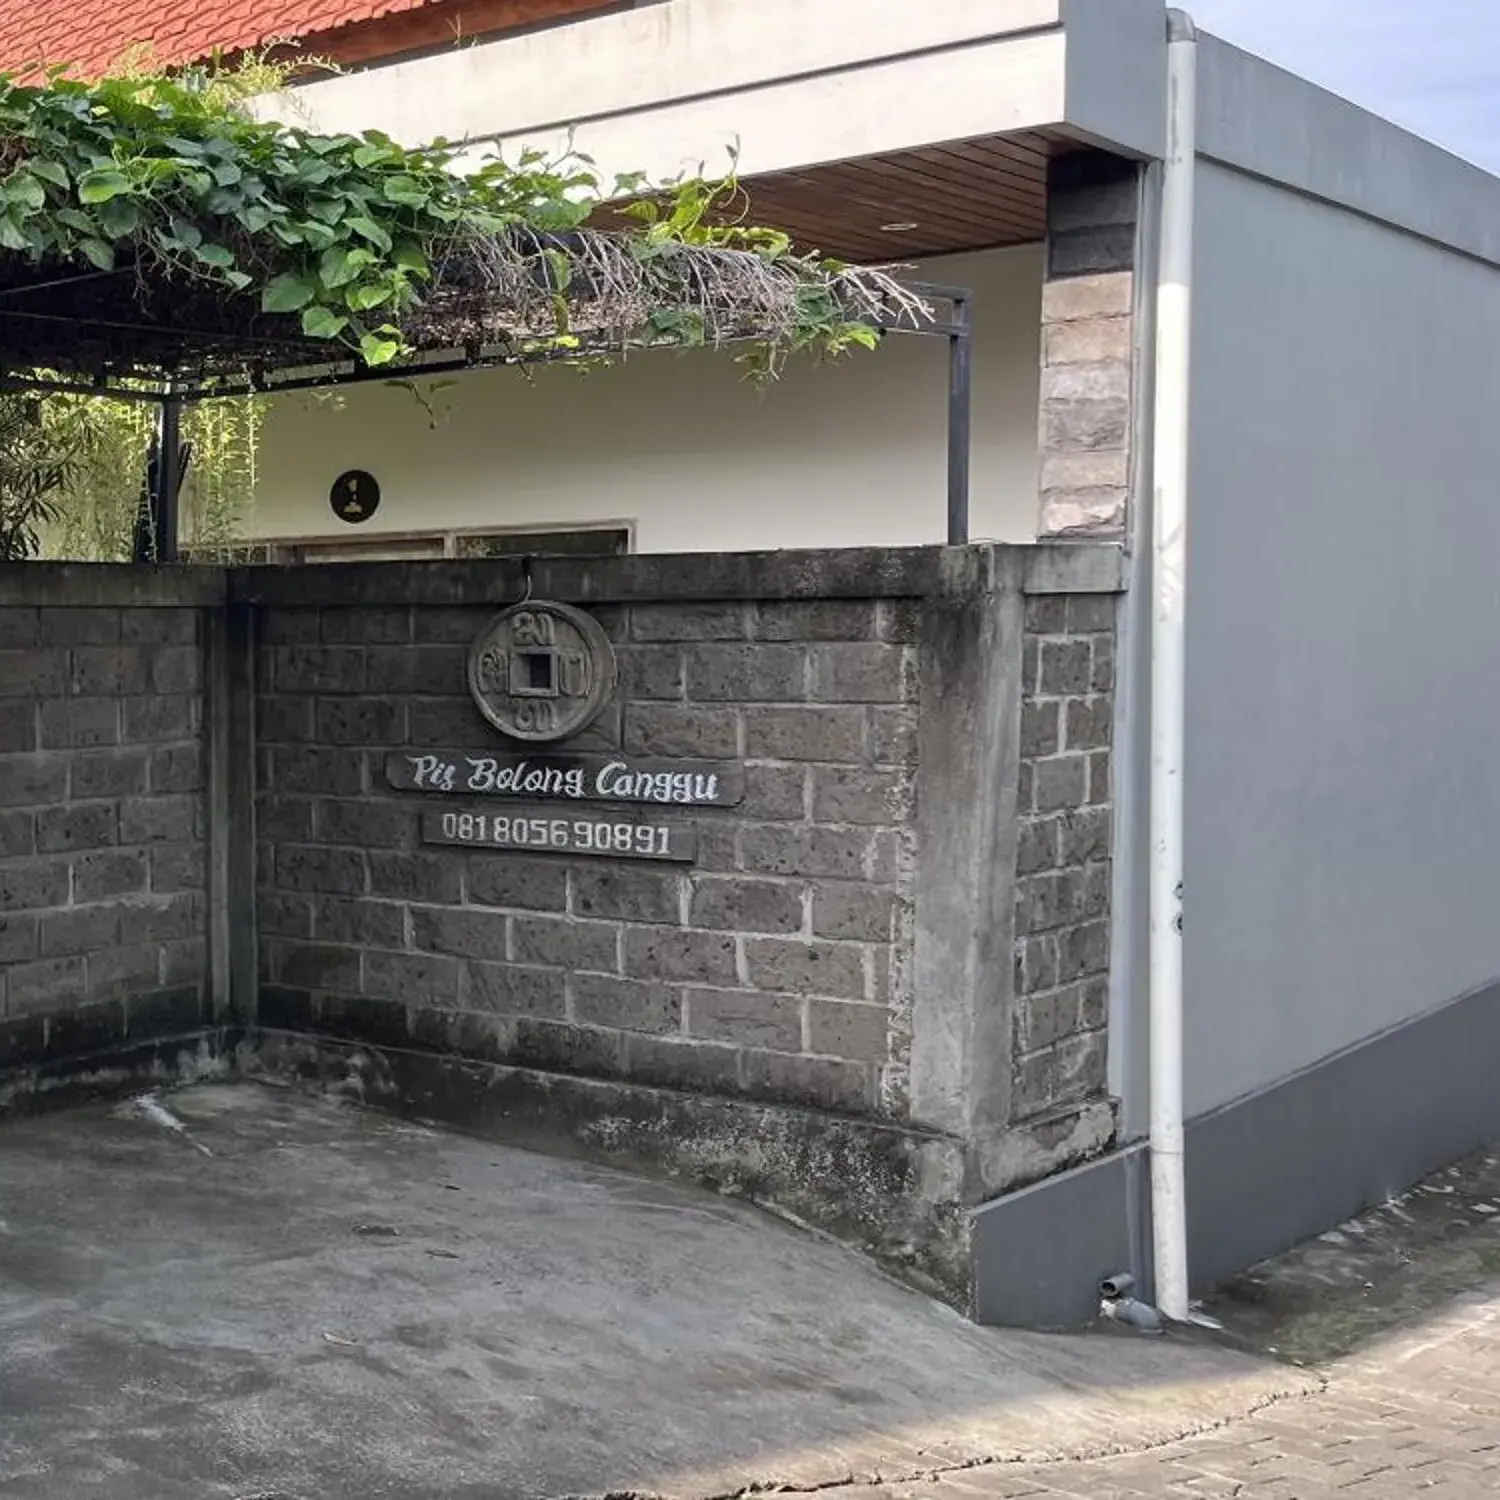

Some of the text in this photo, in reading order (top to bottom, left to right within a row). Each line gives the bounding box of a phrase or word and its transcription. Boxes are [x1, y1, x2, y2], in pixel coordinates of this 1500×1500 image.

[406, 755, 719, 802] Pis Bolong Canggu
